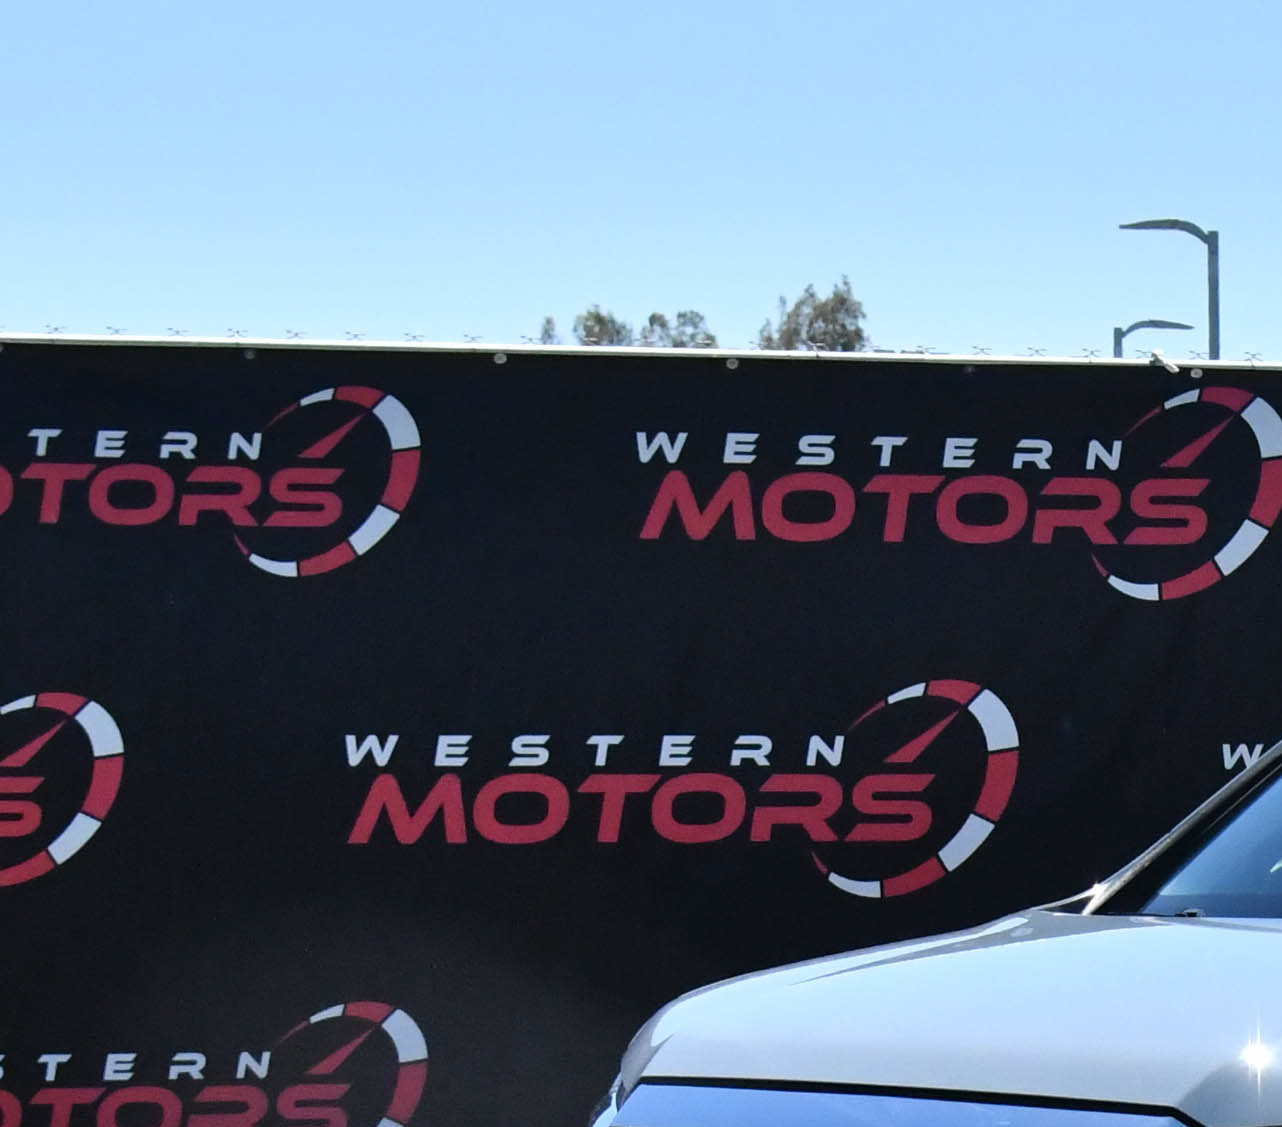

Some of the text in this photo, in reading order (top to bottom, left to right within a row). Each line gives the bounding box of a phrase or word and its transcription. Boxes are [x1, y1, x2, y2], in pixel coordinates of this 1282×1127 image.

[28, 428, 262, 460] TERN
[636, 431, 1123, 471] WESTERN
[0, 462, 345, 527] TORS
[639, 470, 1210, 546] MOTORS
[345, 734, 845, 768] WESTERN
[348, 772, 936, 846] MOTORS
[0, 1051, 271, 1082] TERN
